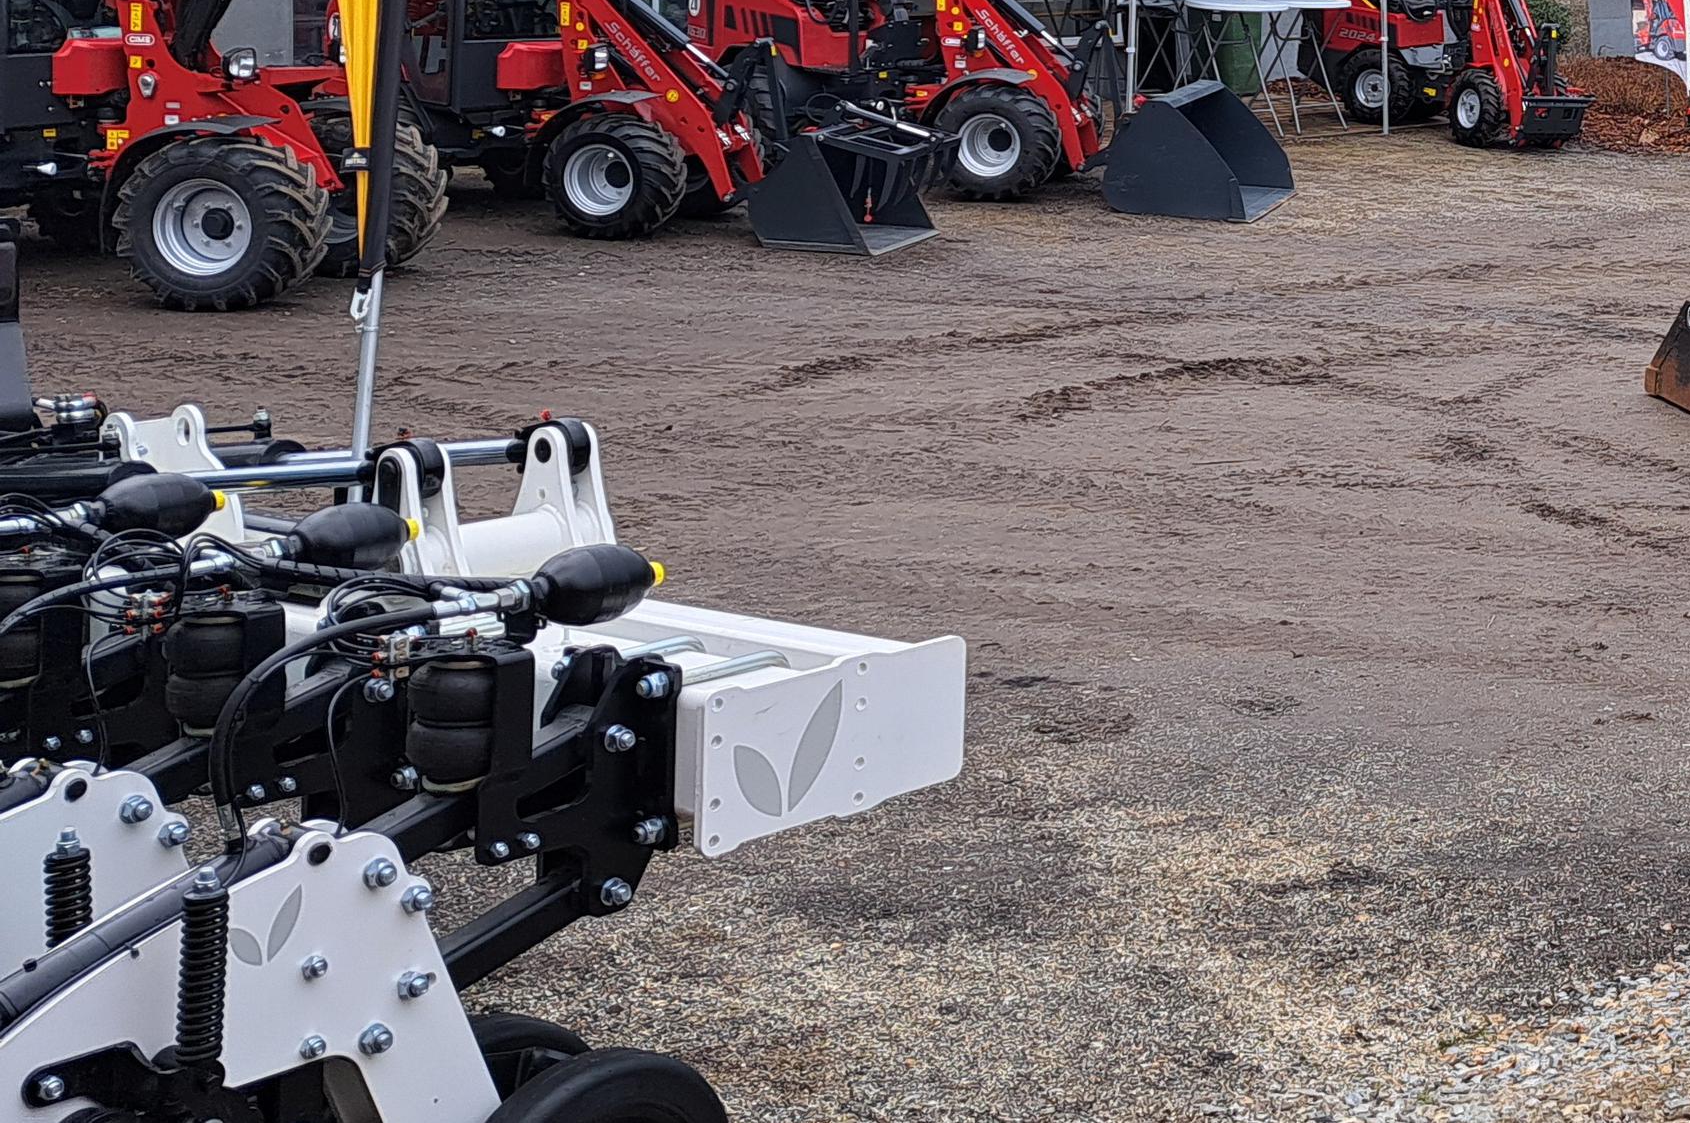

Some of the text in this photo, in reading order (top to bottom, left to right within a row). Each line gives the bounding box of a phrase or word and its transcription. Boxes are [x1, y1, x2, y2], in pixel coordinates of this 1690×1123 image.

[604, 21, 661, 82] Schäffer
[974, 9, 1025, 64] Schäffer
[1339, 27, 1377, 43] 2024
